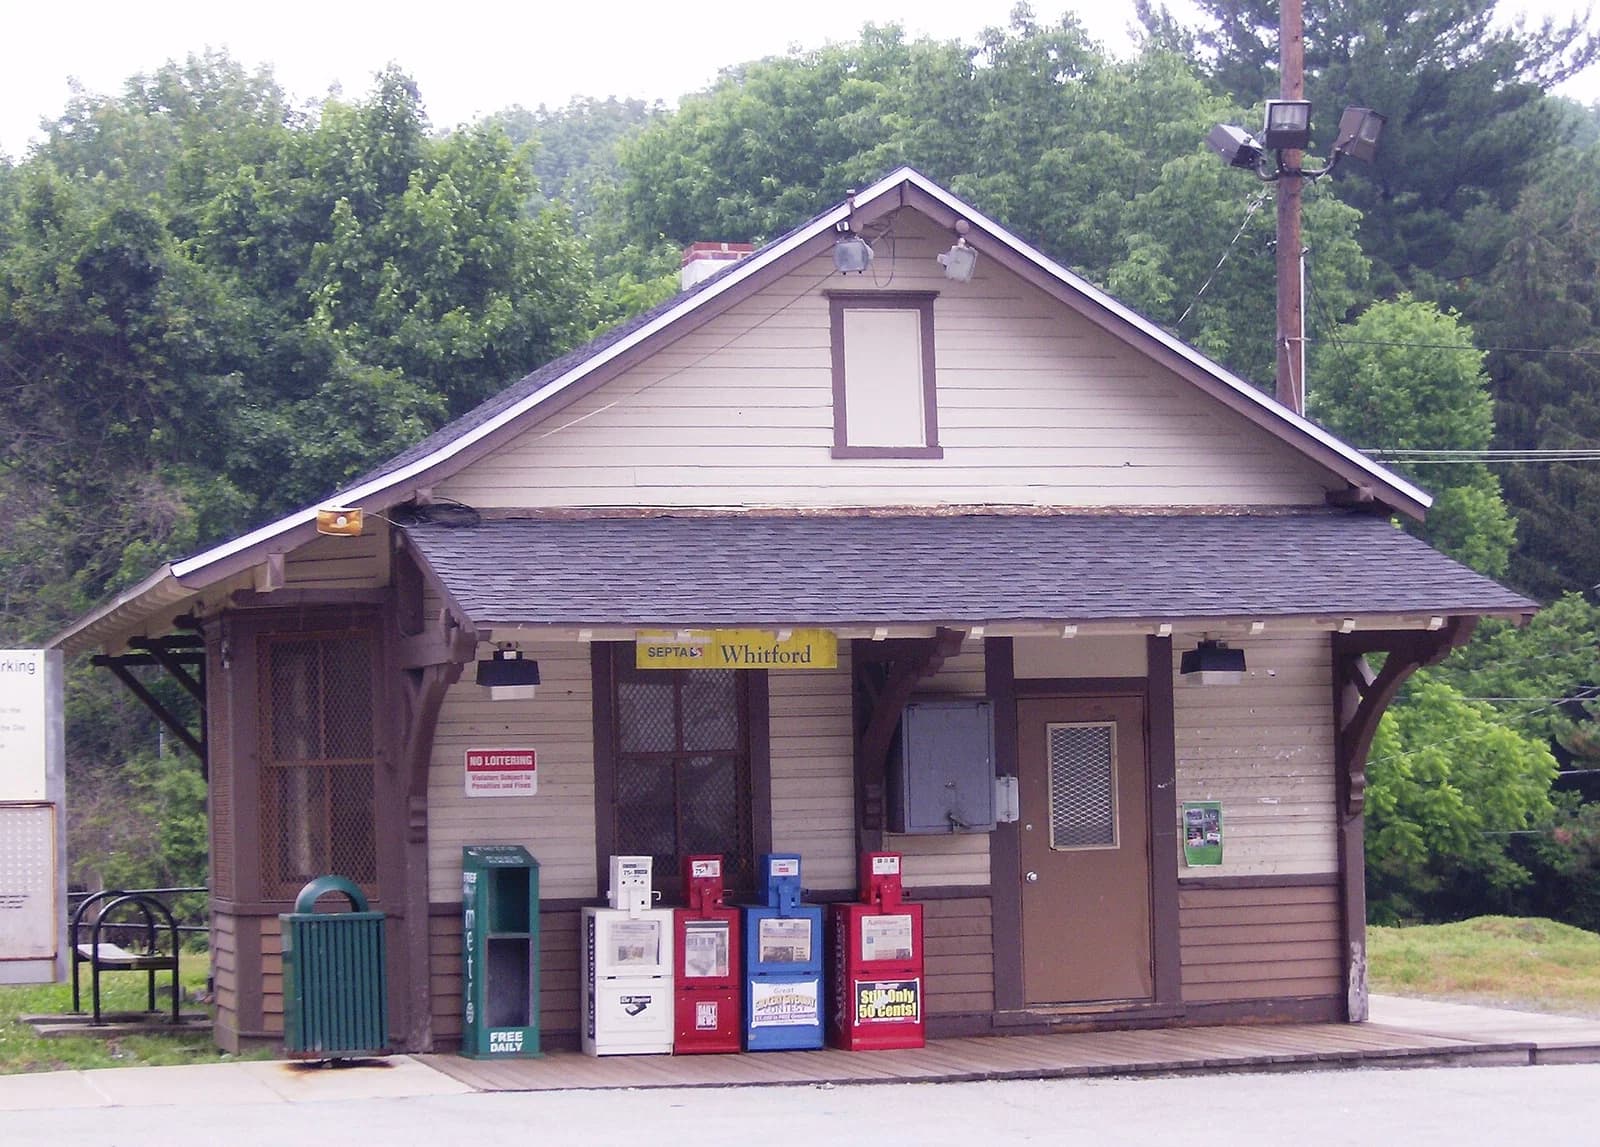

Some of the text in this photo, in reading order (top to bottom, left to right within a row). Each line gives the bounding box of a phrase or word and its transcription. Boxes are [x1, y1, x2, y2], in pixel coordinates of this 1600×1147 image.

[648, 647, 687, 657] SEPTA
[721, 644, 812, 664] Whitford
[470, 755, 533, 766] NO LOITERING
[501, 774, 523, 782] Subject
[861, 989, 915, 1003] Still Only
[860, 1004, 875, 1018] 50
[490, 1032, 523, 1041] FREE
[490, 1042, 523, 1052] DAILY
